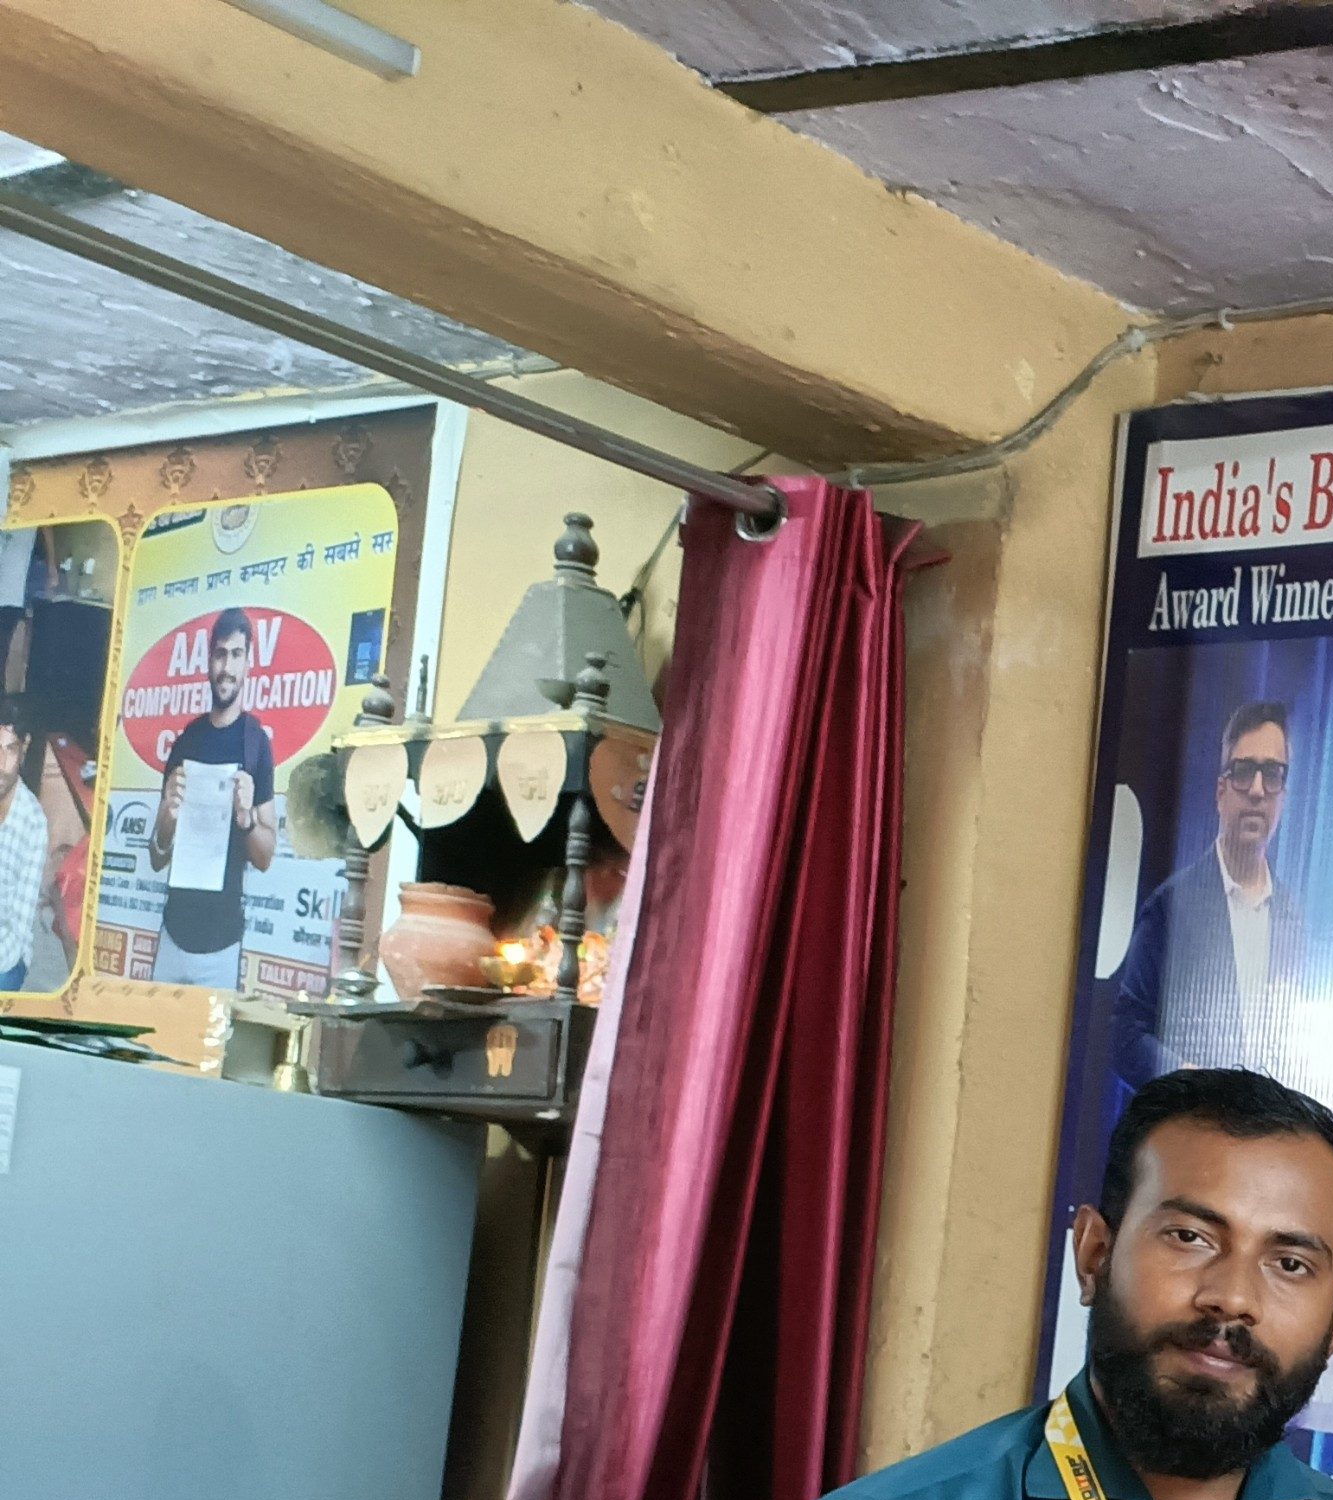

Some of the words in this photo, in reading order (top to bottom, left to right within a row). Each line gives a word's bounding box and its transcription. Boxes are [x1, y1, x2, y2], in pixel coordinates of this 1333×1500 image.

[1152, 457, 1293, 543] India's
[297, 544, 314, 569] की
[324, 532, 361, 564] सबसे
[1149, 567, 1242, 631] Award
